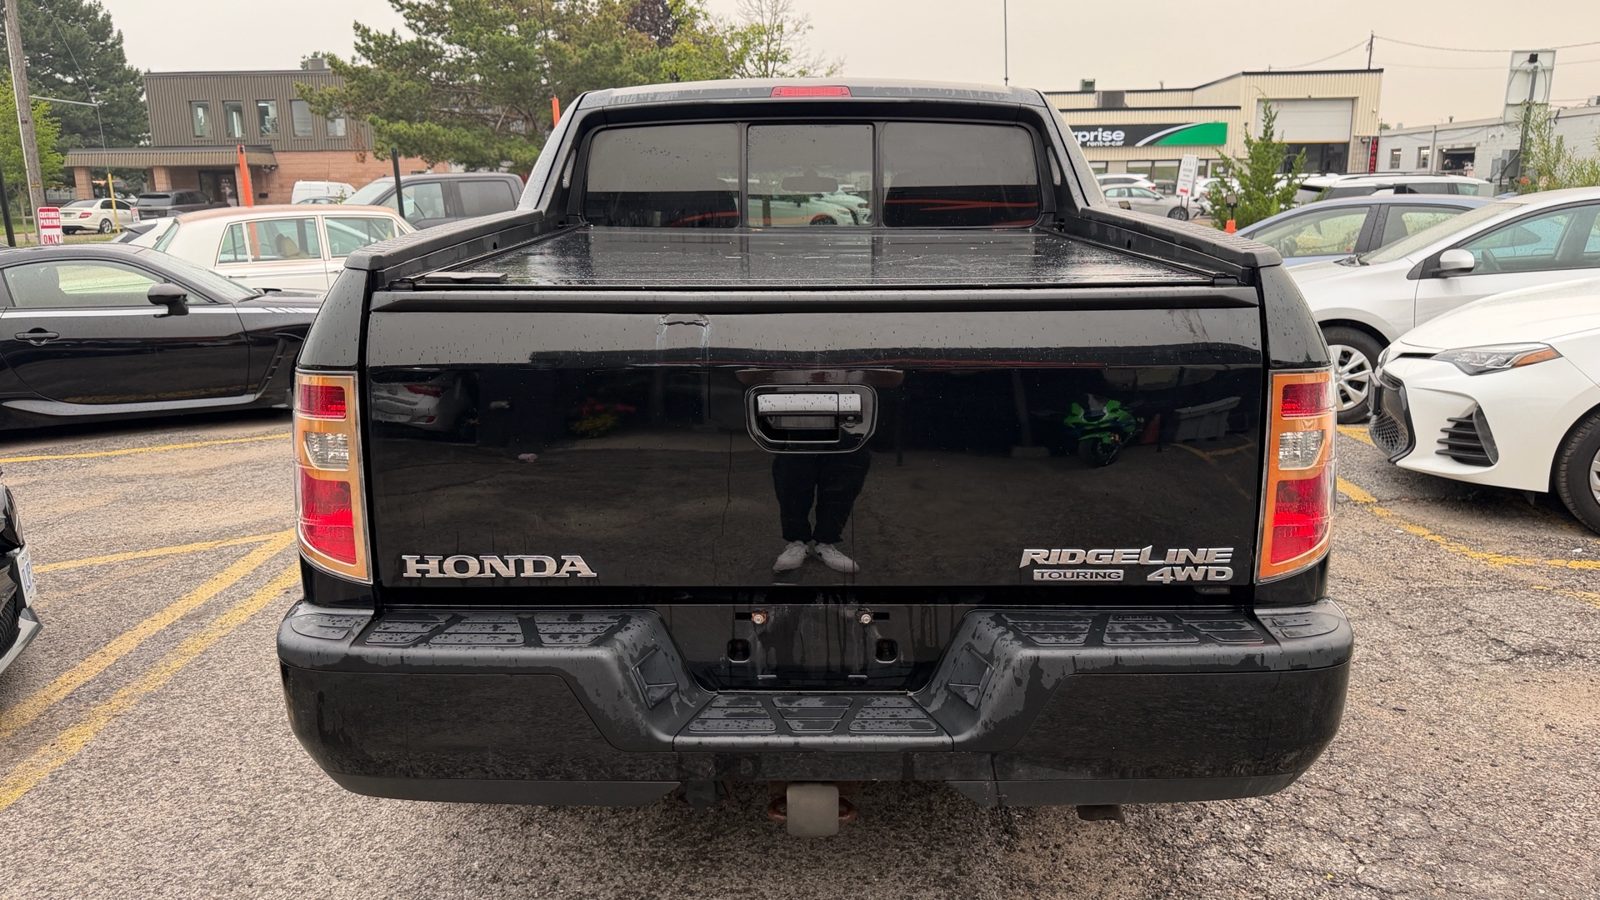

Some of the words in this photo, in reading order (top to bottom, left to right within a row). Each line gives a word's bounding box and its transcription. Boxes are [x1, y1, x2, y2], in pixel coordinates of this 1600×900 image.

[43, 234, 60, 244] ONLY
[1019, 545, 1234, 568] RIDGELINE
[402, 555, 598, 578] HONDA
[1036, 571, 1121, 580] TOURING
[1147, 567, 1233, 584] 4WD
